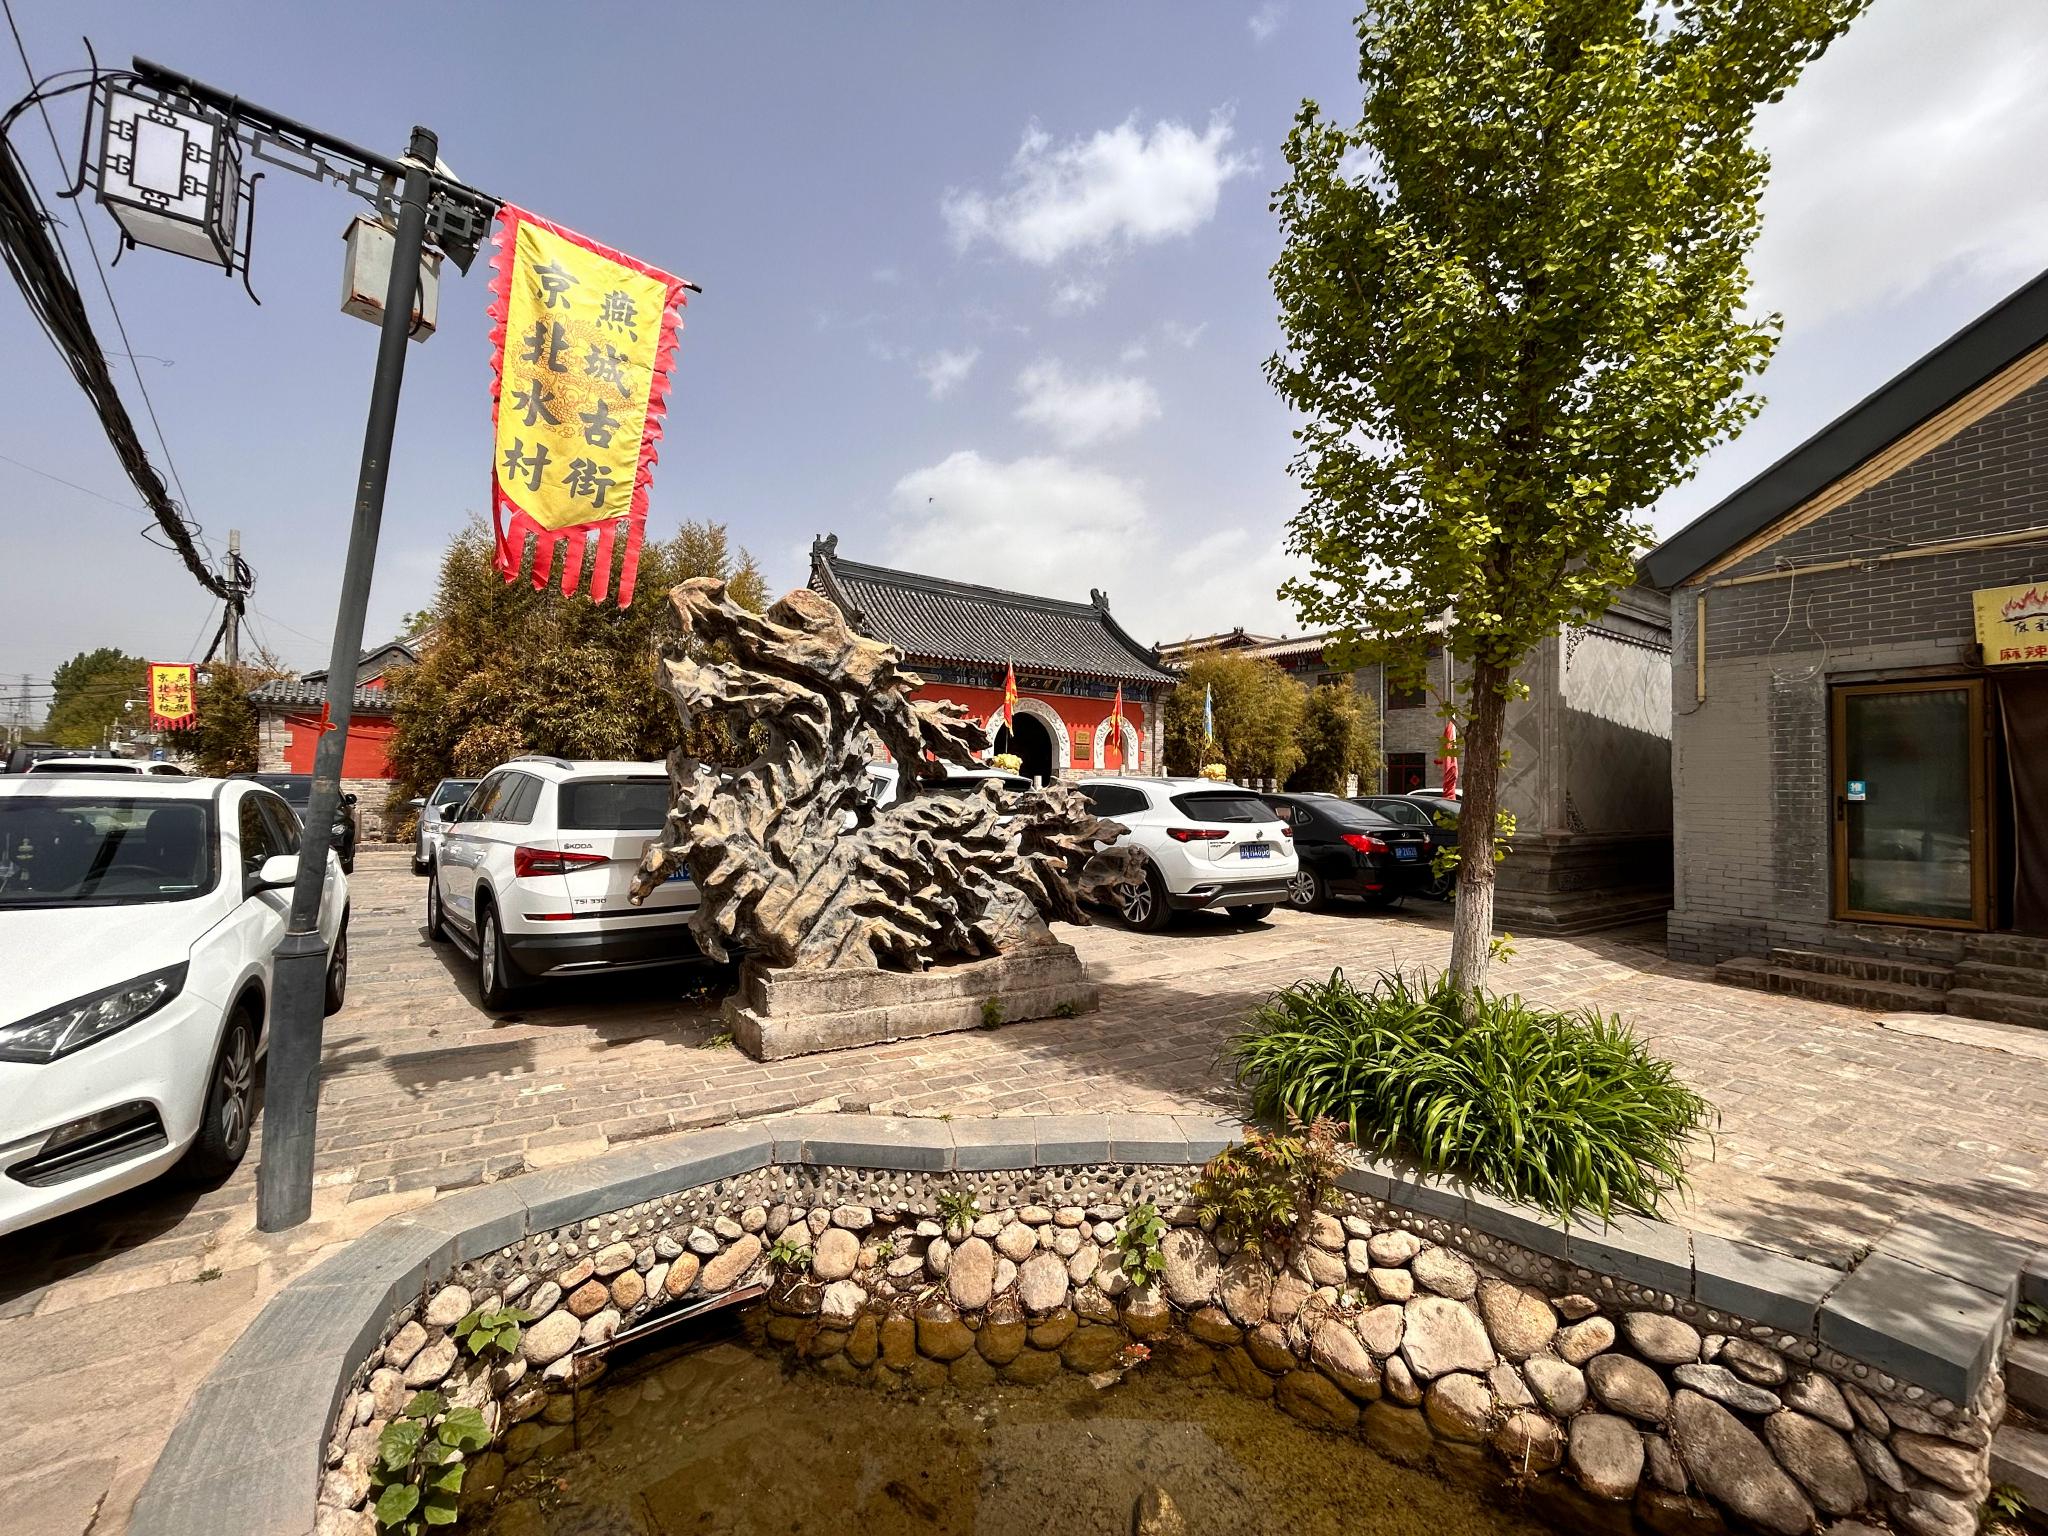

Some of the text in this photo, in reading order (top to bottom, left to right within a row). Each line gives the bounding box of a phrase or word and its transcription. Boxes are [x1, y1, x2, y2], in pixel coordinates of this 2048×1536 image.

[502, 259, 580, 493] 京北水村
[562, 289, 639, 509] 燕城古街
[2000, 645, 2047, 661] 麻辣
